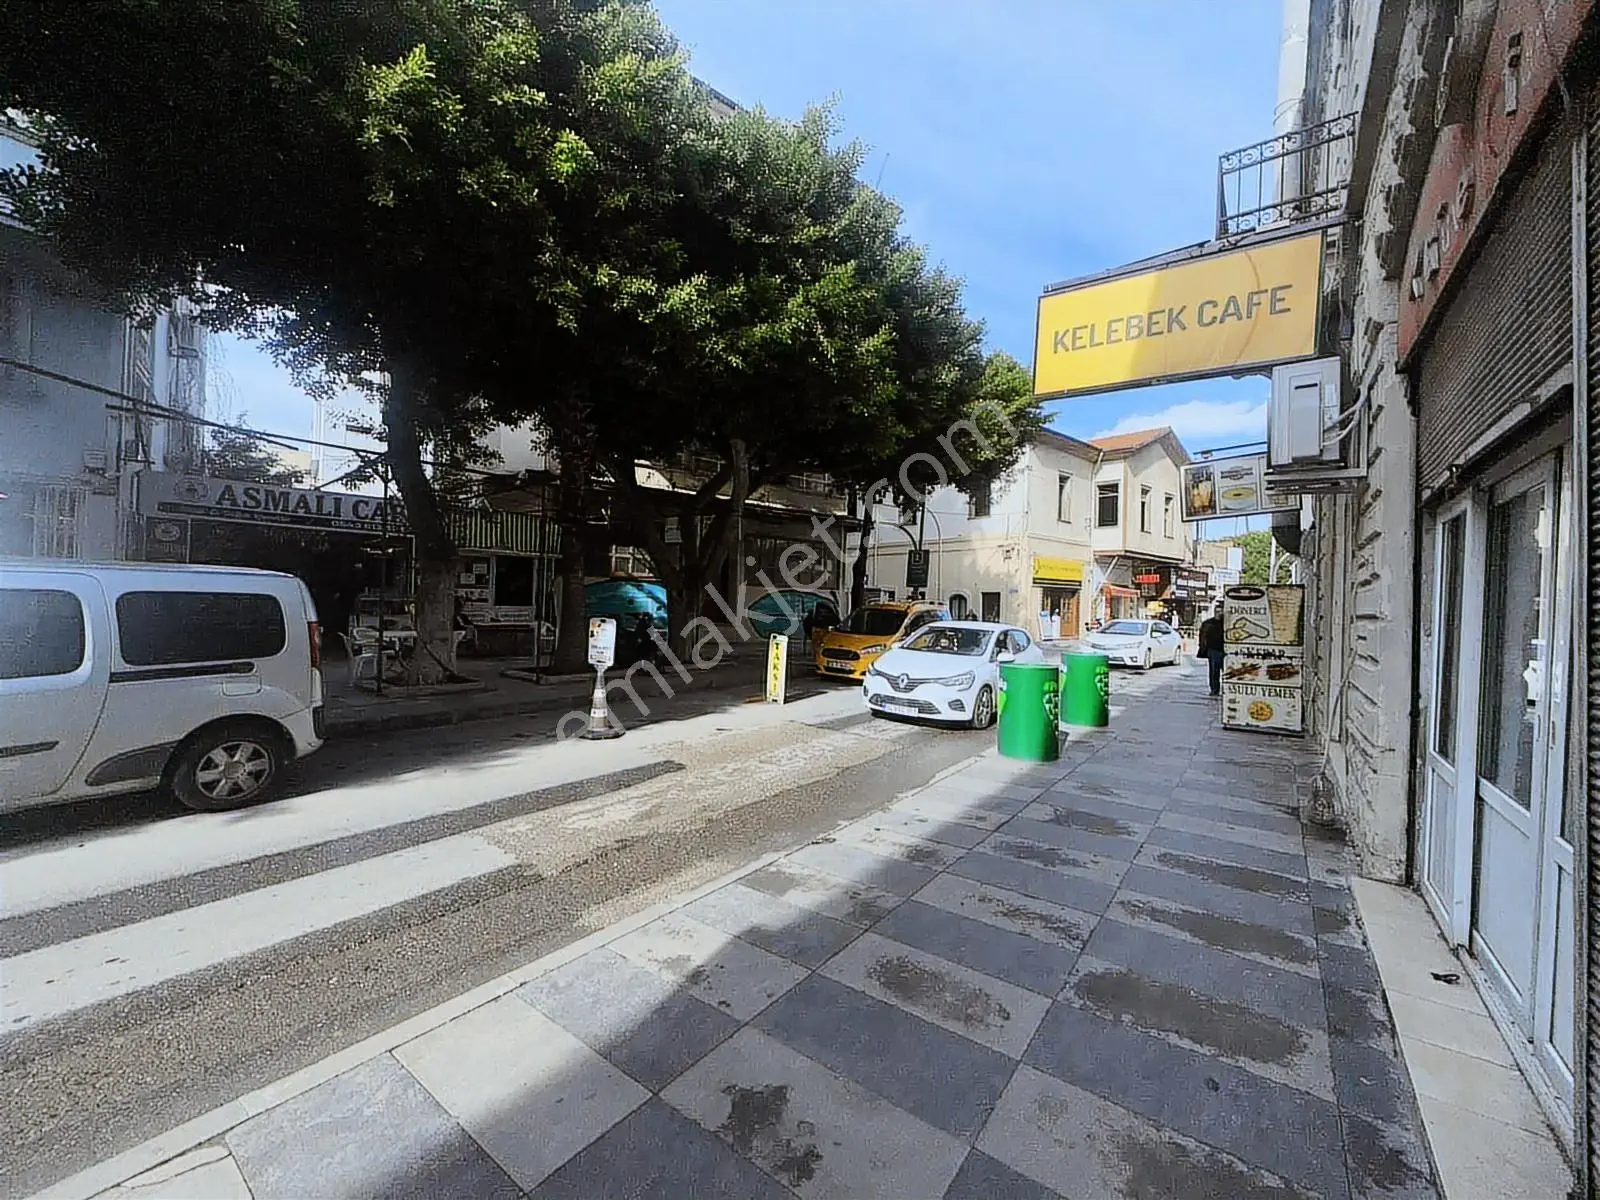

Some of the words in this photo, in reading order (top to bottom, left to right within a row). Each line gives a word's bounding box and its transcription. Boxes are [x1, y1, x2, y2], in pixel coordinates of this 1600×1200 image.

[1053, 304, 1187, 354] KELEBEK
[1197, 284, 1293, 328] CAFE
[215, 484, 345, 518] ASMALI
